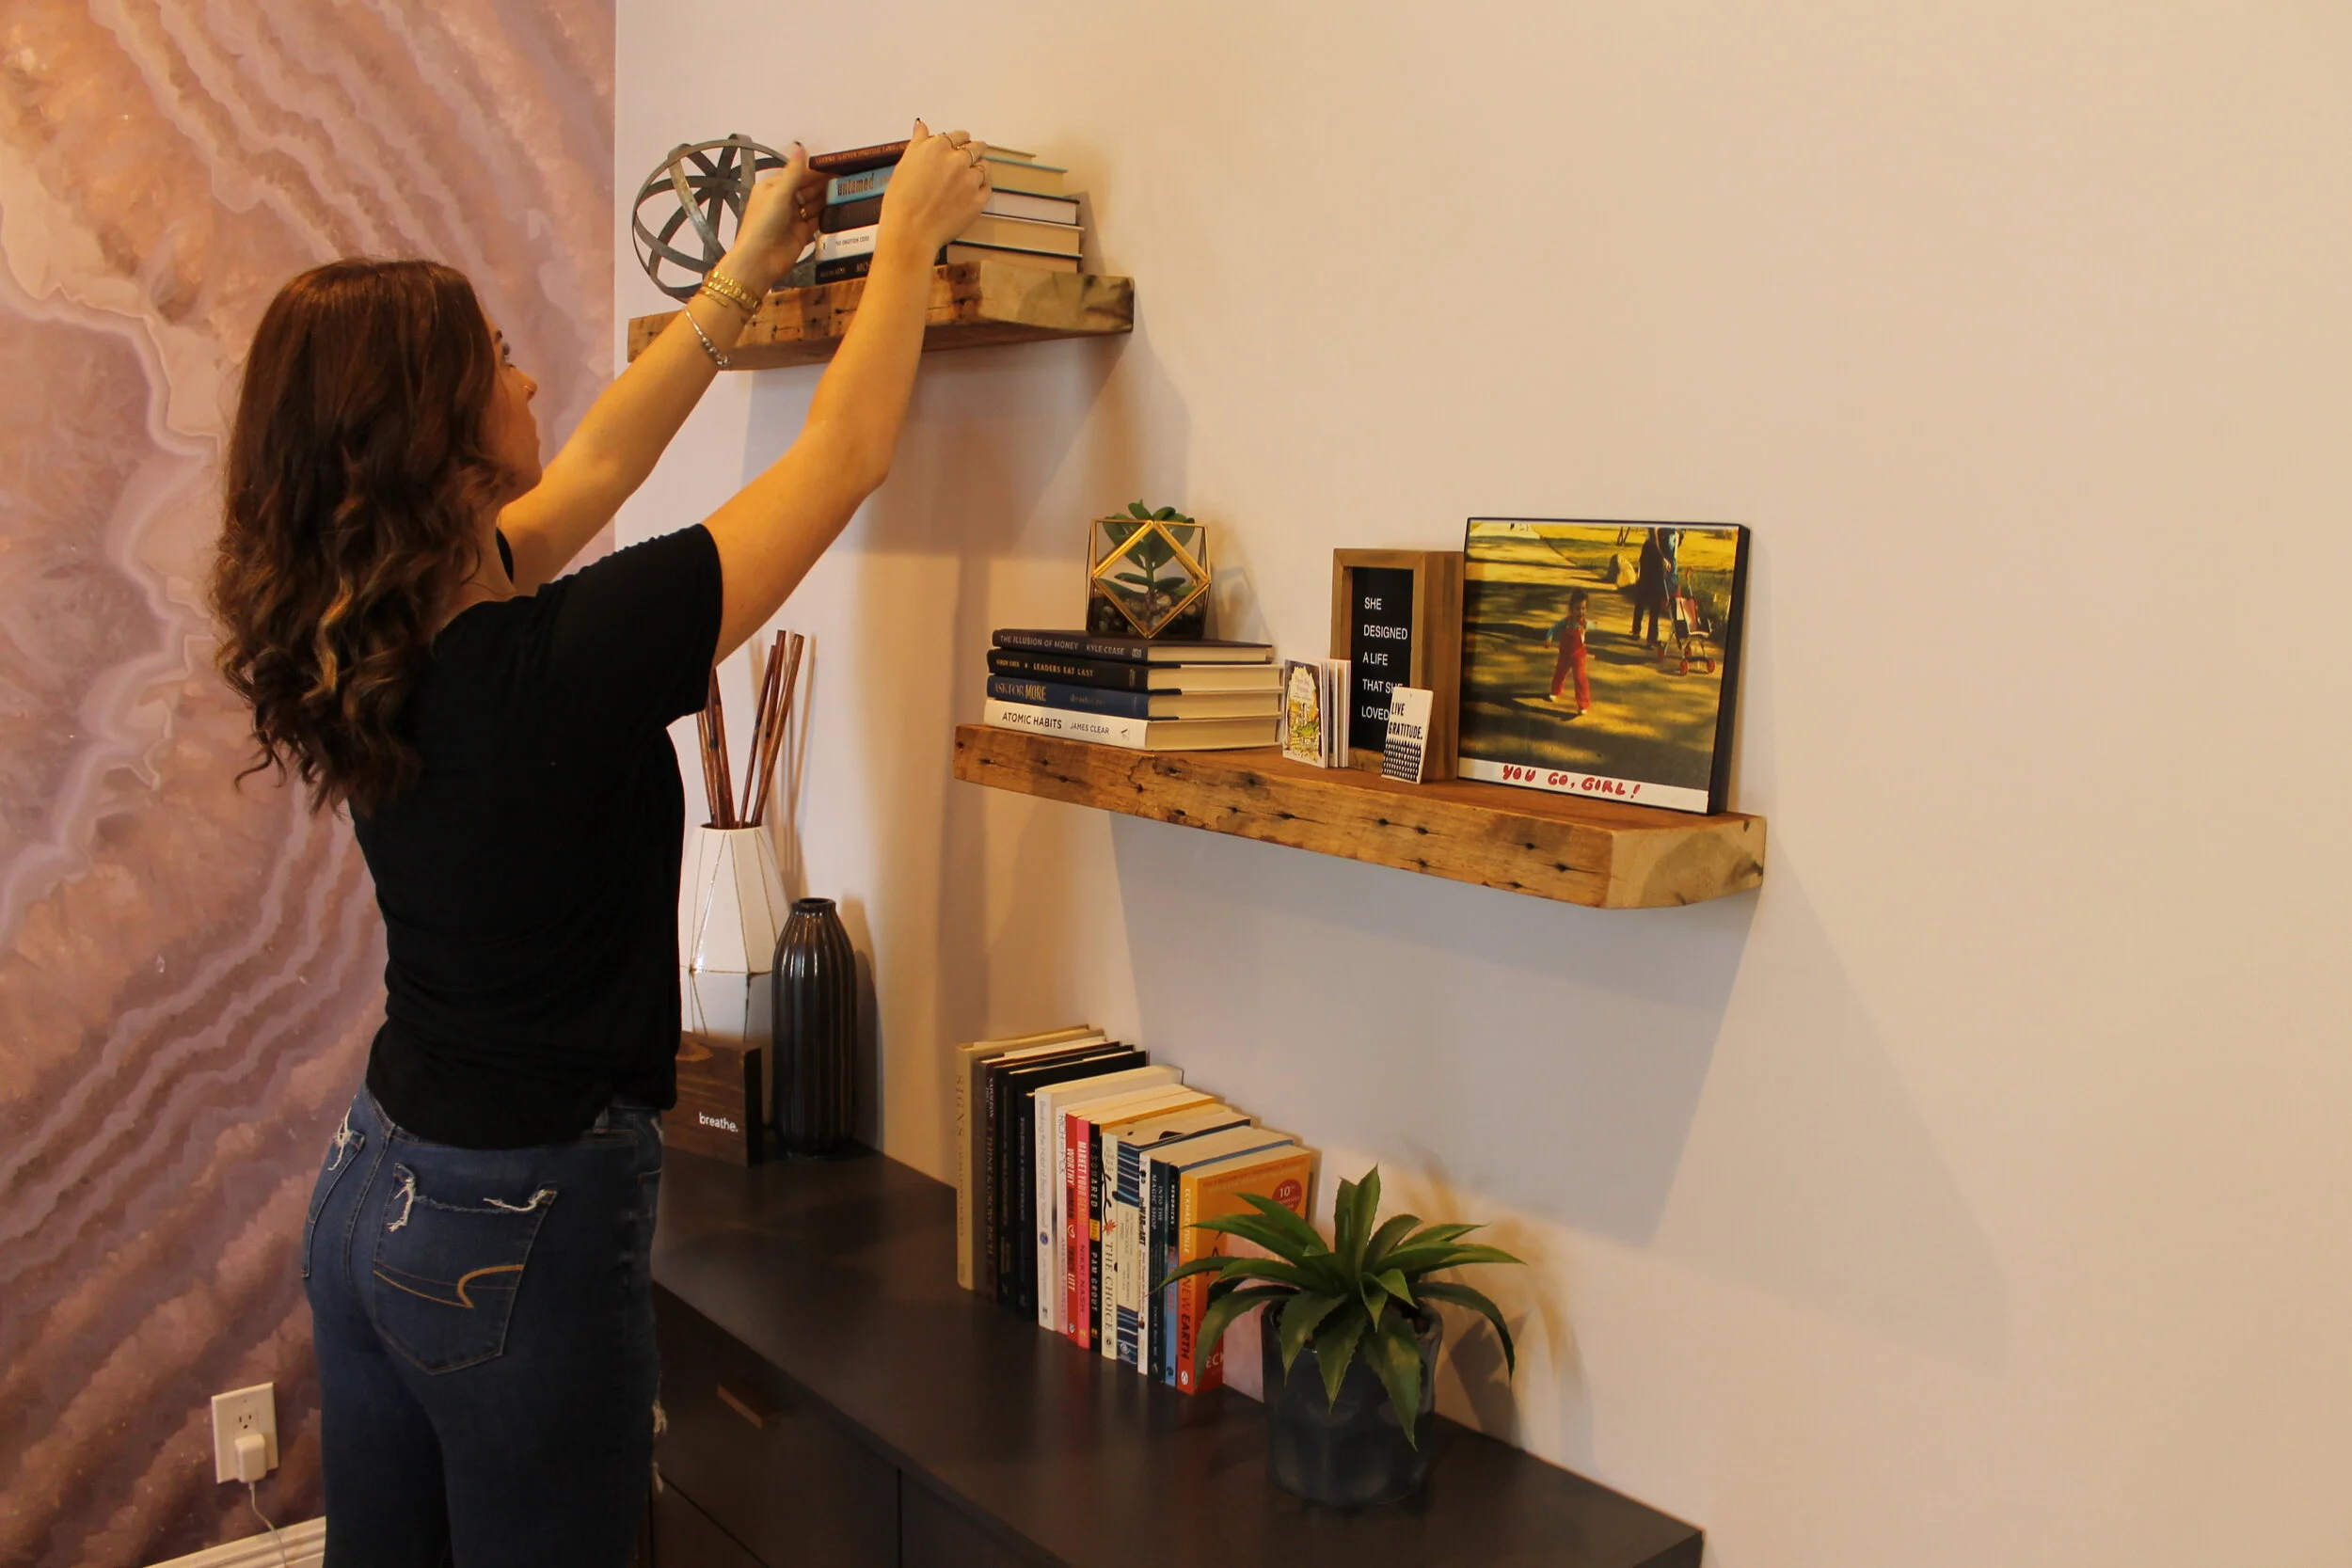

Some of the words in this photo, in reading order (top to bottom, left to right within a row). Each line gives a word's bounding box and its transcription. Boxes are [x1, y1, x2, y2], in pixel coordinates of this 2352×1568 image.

[837, 172, 875, 196] untamed
[1364, 596, 1382, 610] SHE
[1363, 624, 1408, 641] DESIGNED
[1000, 635, 1011, 644] THE
[1013, 636, 1042, 646] ILLUSION
[1054, 641, 1079, 650] MONEY
[1086, 644, 1104, 654] KYLE
[1104, 645, 1125, 656] CEASE
[1033, 662, 1061, 673] LEADERS
[1063, 665, 1075, 675] EAT
[1077, 667, 1093, 677] LAST
[1362, 652, 1370, 663] A
[1370, 654, 1389, 666] LIFE
[1025, 684, 1047, 702] MORE
[1362, 678, 1384, 692] THAT
[1361, 705, 1390, 721] LOVED
[1391, 702, 1406, 716] LIVE
[1002, 711, 1031, 725] ATOMIC
[1033, 716, 1062, 729] HABITS
[1070, 721, 1089, 733] JAMES
[1089, 725, 1109, 735] CLEAR
[1388, 721, 1423, 739] GRATITUDE.
[1502, 765, 1536, 783] YOU
[1547, 771, 1576, 789] GO,
[956, 1074, 964, 1137] SIGNS
[698, 1112, 739, 1132] breathe.
[1067, 1148, 1075, 1186] WORTHY
[1077, 1141, 1087, 1174] MARKET
[1077, 1175, 1087, 1197] YOUR
[1104, 1242, 1114, 1273] THE
[1104, 1275, 1114, 1332] CHOICE
[1182, 1276, 1192, 1312] NEW
[1181, 1313, 1191, 1360] EARTH
